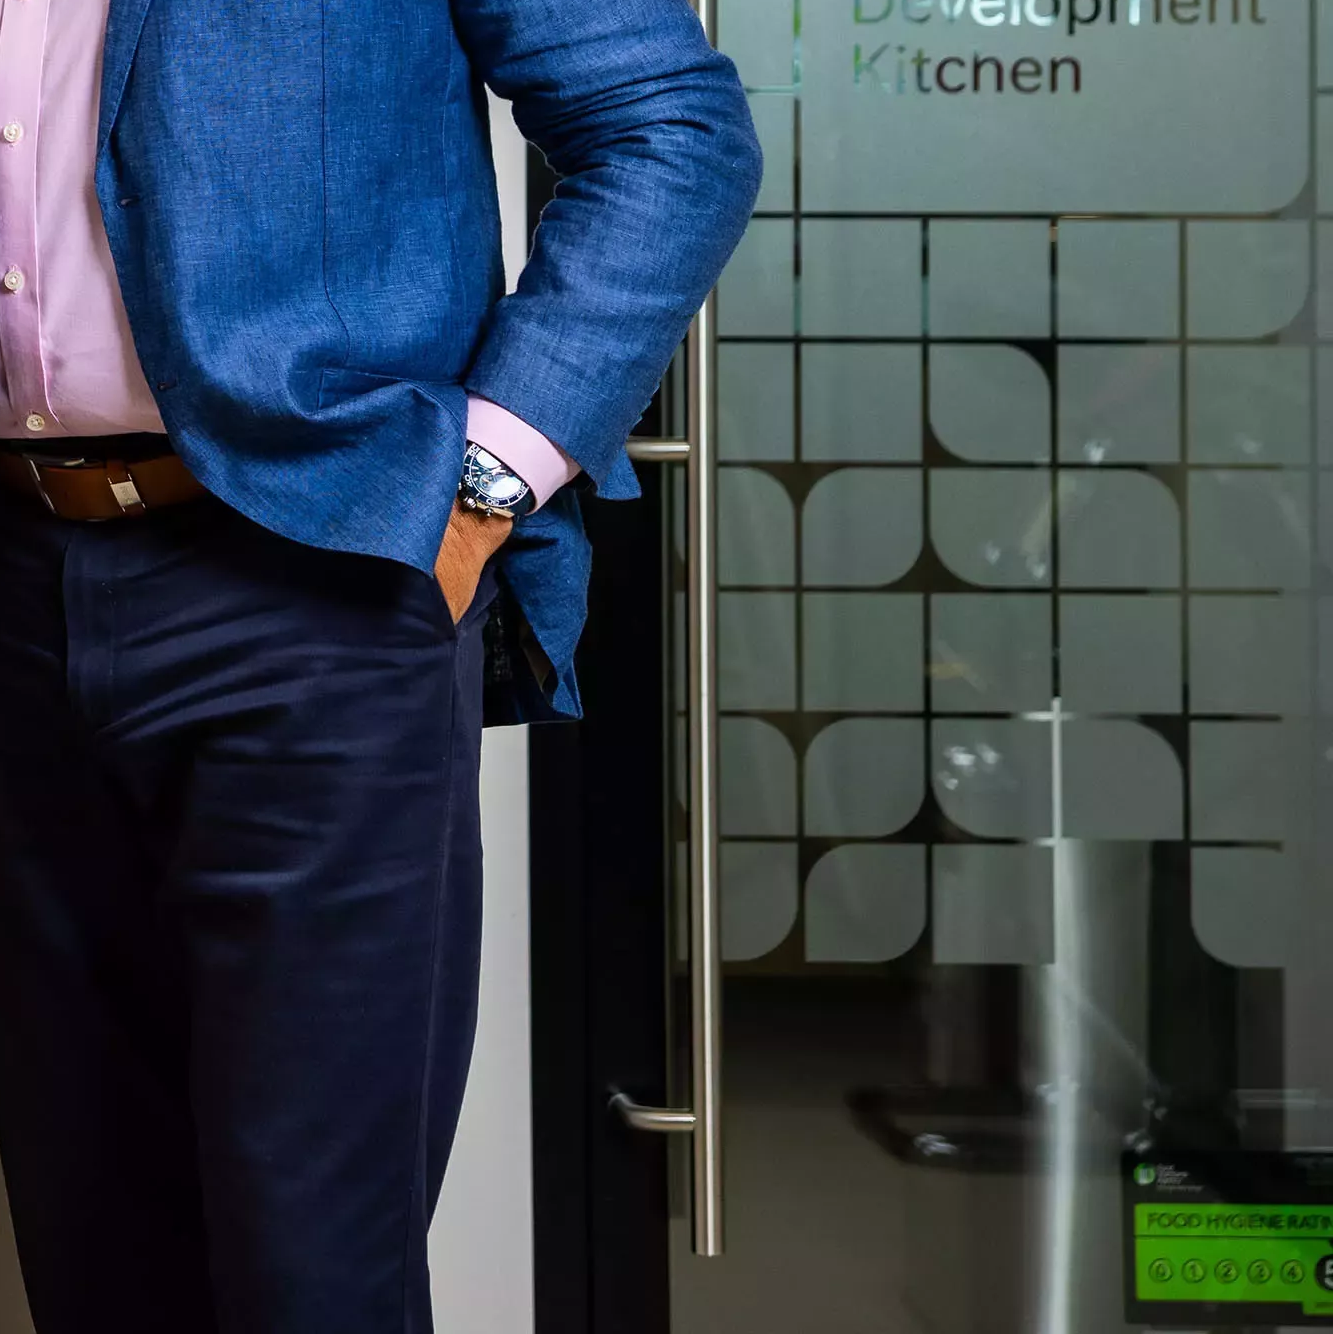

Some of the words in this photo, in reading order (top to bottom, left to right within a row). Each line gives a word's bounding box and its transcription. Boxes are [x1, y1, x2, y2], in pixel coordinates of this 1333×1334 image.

[852, 43, 1082, 94] Kitchen
[1147, 1213, 1201, 1230] FOOD
[1207, 1213, 1284, 1231] HYGIENE
